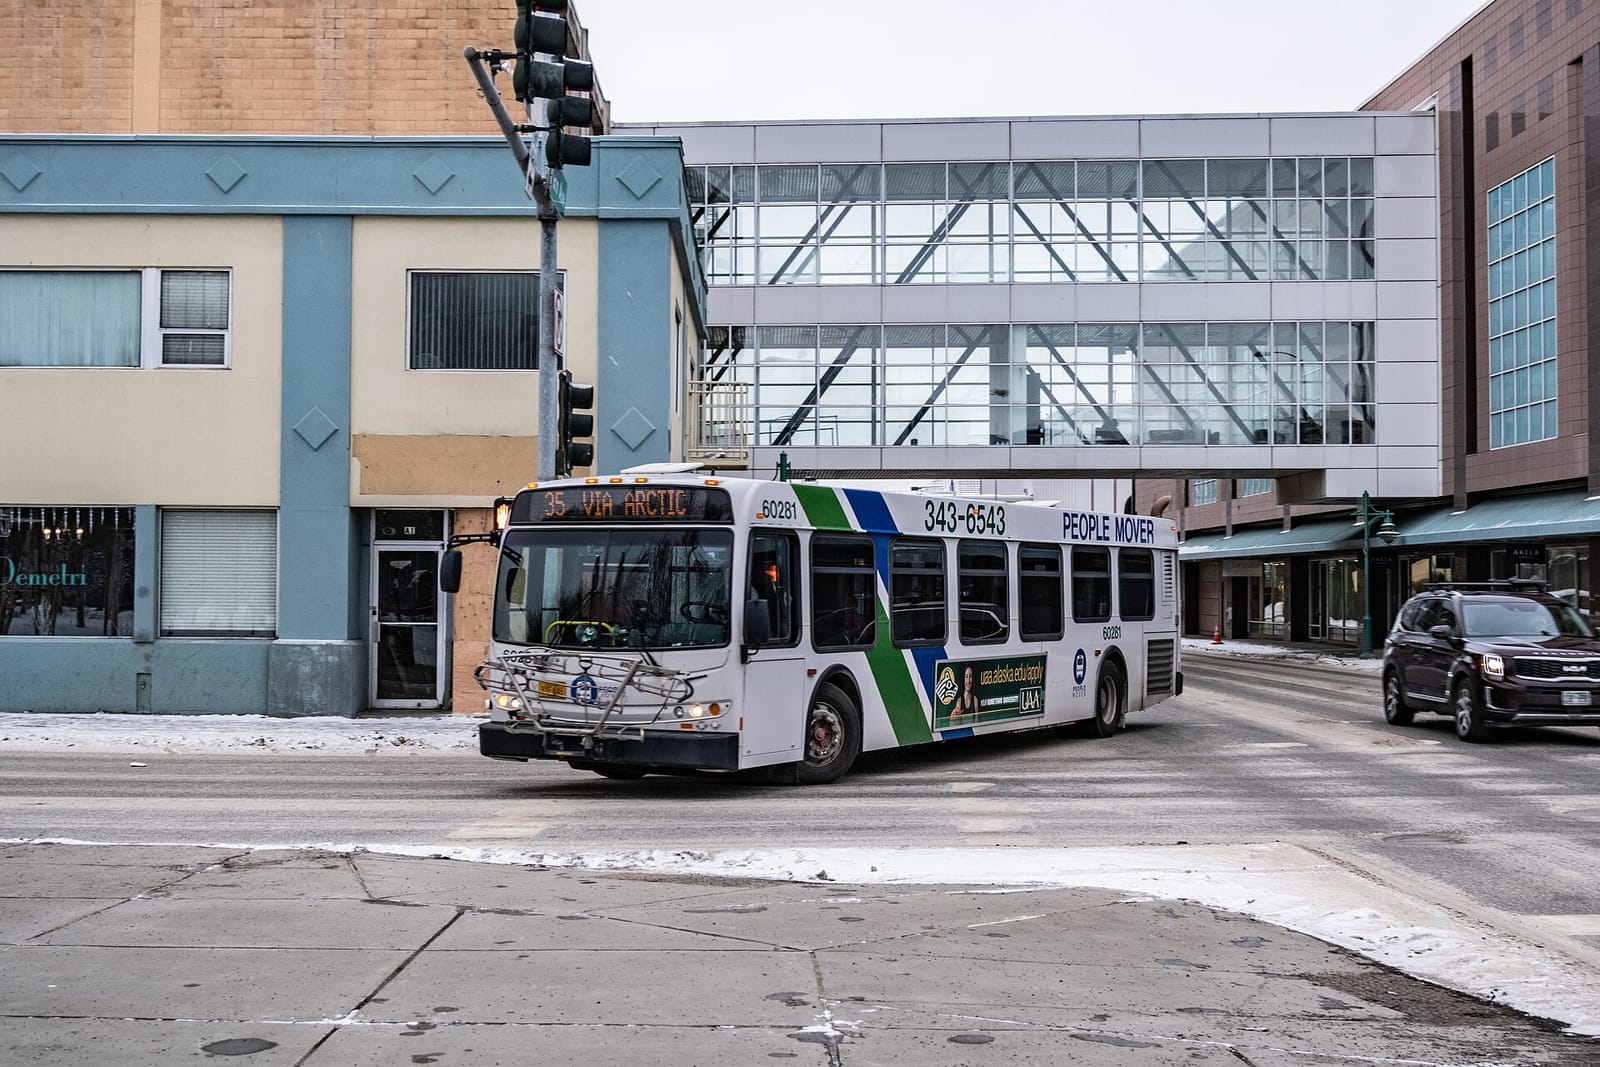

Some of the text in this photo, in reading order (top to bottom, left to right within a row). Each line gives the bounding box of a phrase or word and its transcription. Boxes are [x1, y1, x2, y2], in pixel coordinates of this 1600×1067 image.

[544, 490, 688, 517] 35 VIA ARCTIC
[762, 499, 797, 520] 60281
[924, 499, 1006, 535] 343-6543
[1063, 511, 1155, 545] PEOPLE MOVER
[1102, 625, 1122, 640] 60281
[980, 661, 1044, 686] uaa.alaska.edu/apply
[1021, 689, 1040, 711] UAA
